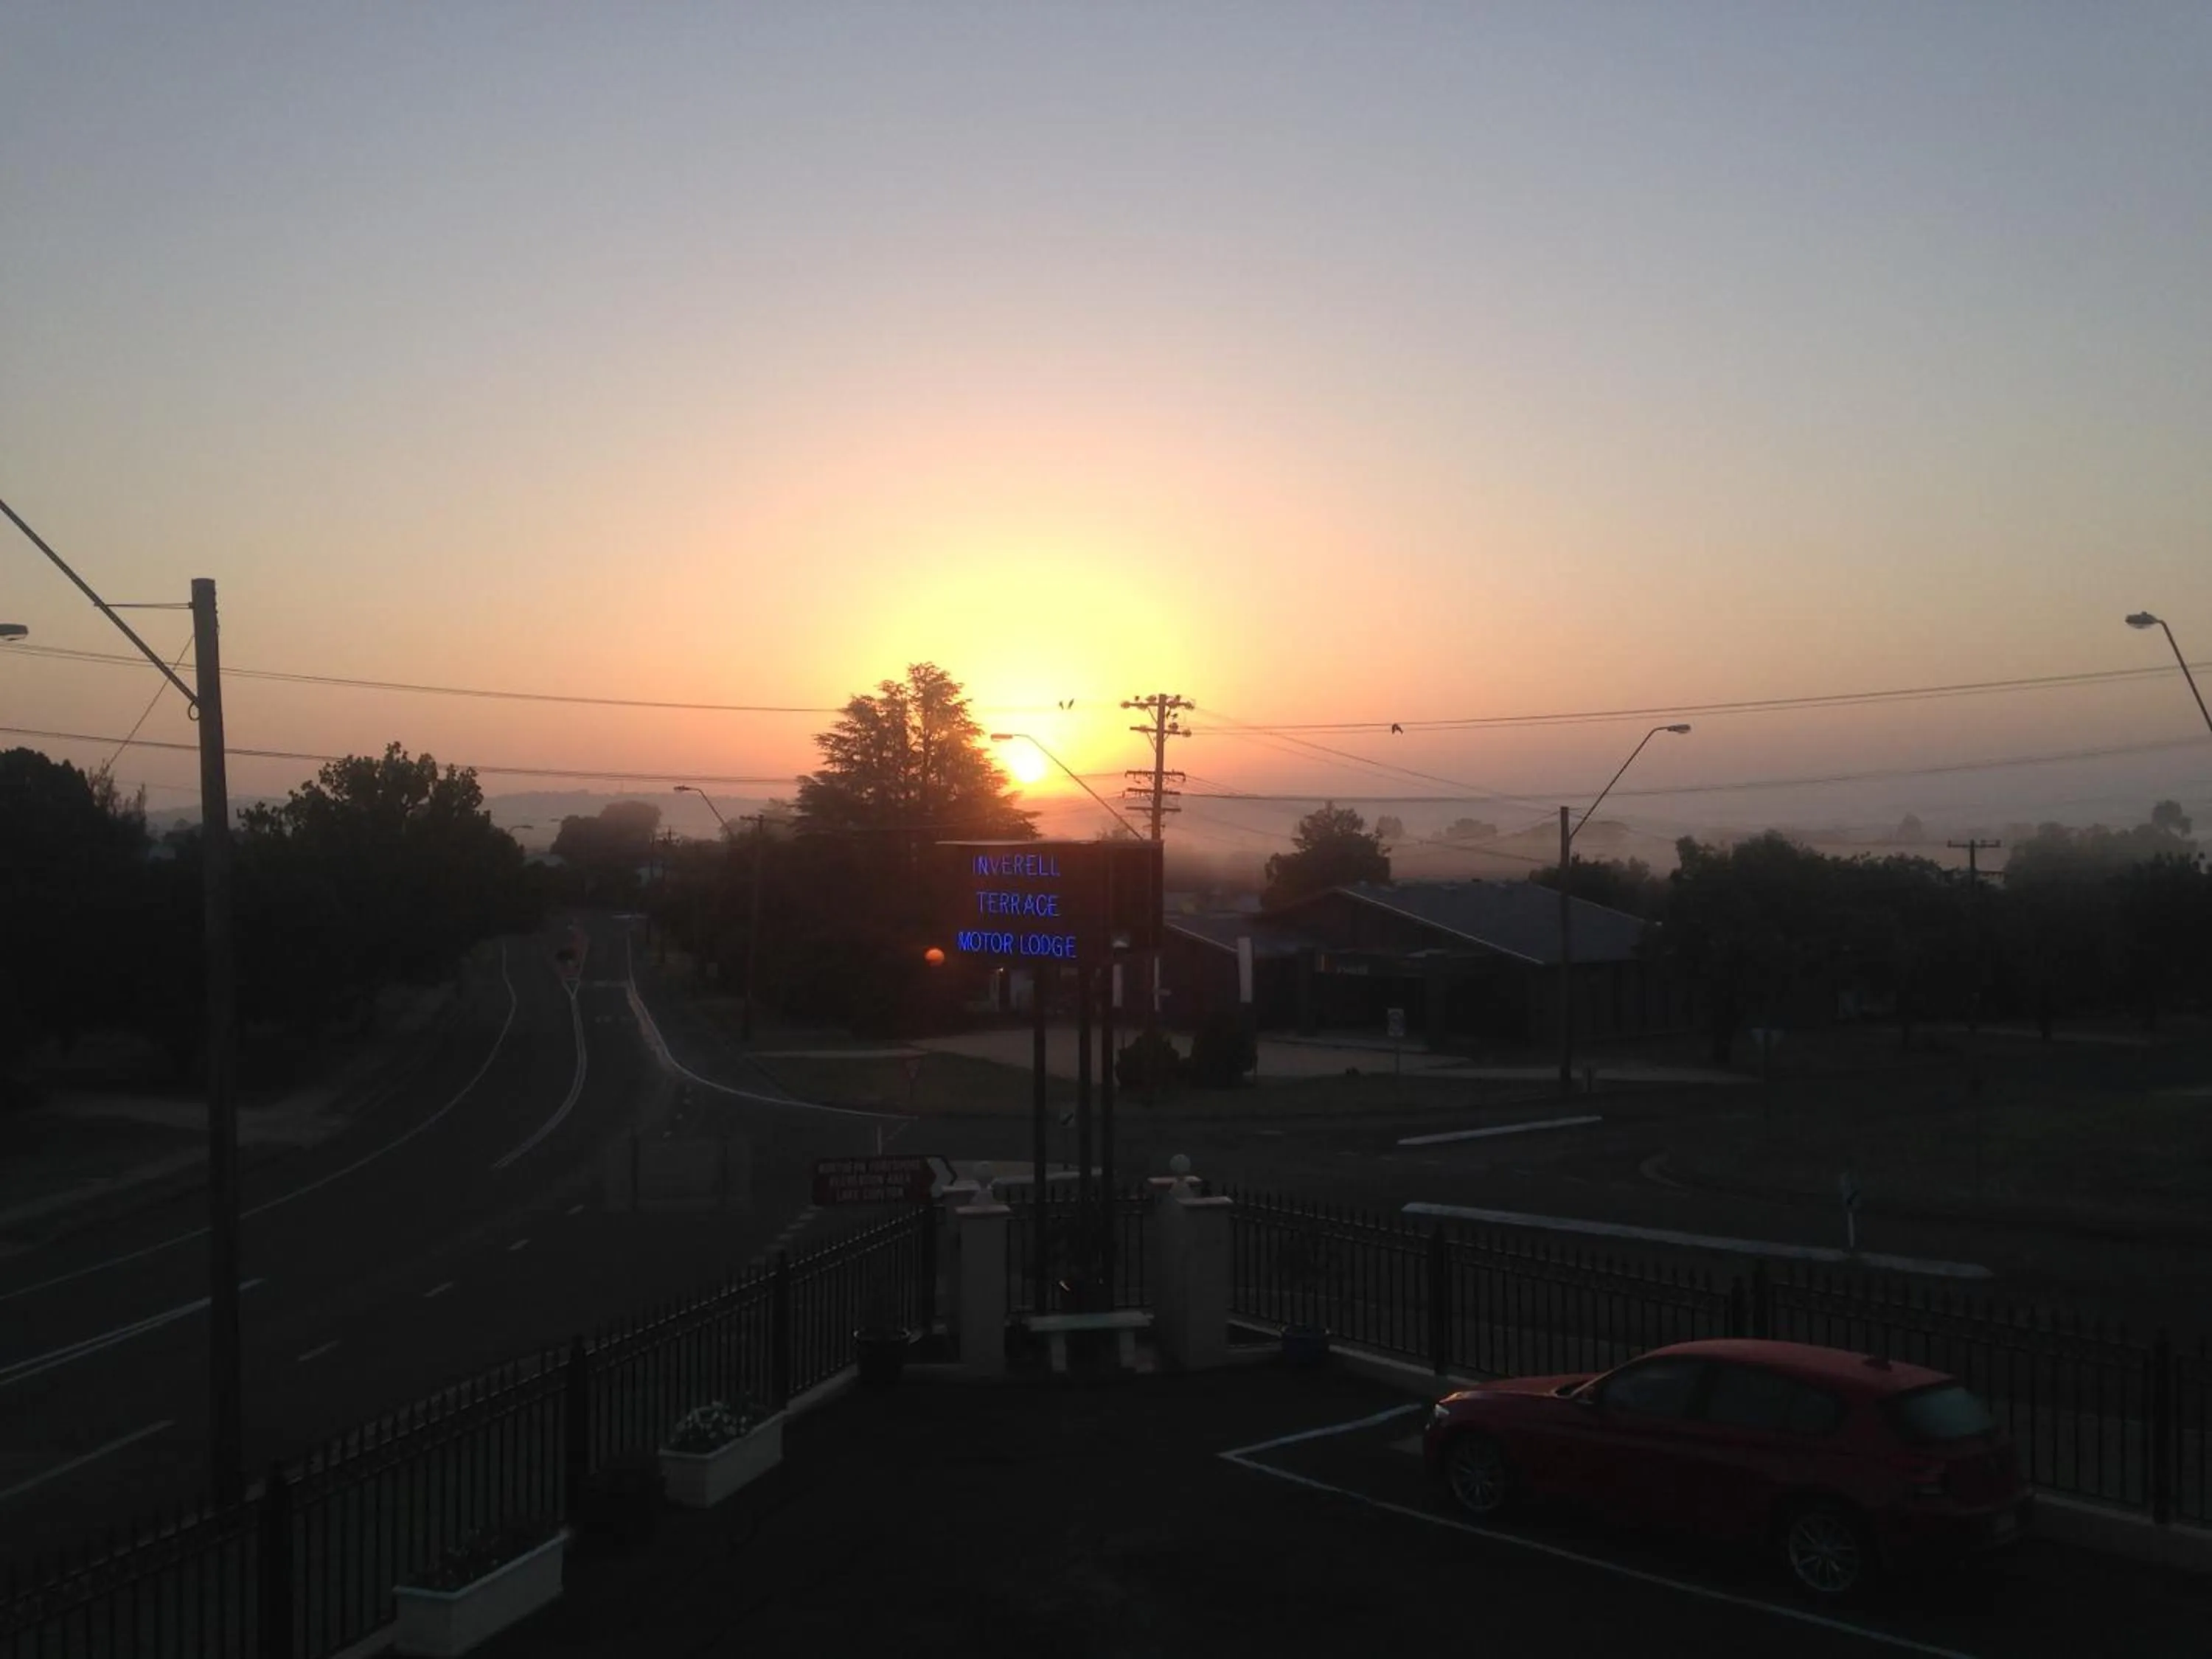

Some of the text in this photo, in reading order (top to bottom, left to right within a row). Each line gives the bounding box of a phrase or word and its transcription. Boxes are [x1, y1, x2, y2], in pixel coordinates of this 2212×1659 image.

[973, 854, 1060, 876] INVERELL
[975, 891, 1062, 917] TERRACE
[958, 931, 1077, 958] MOTOR LODGE
